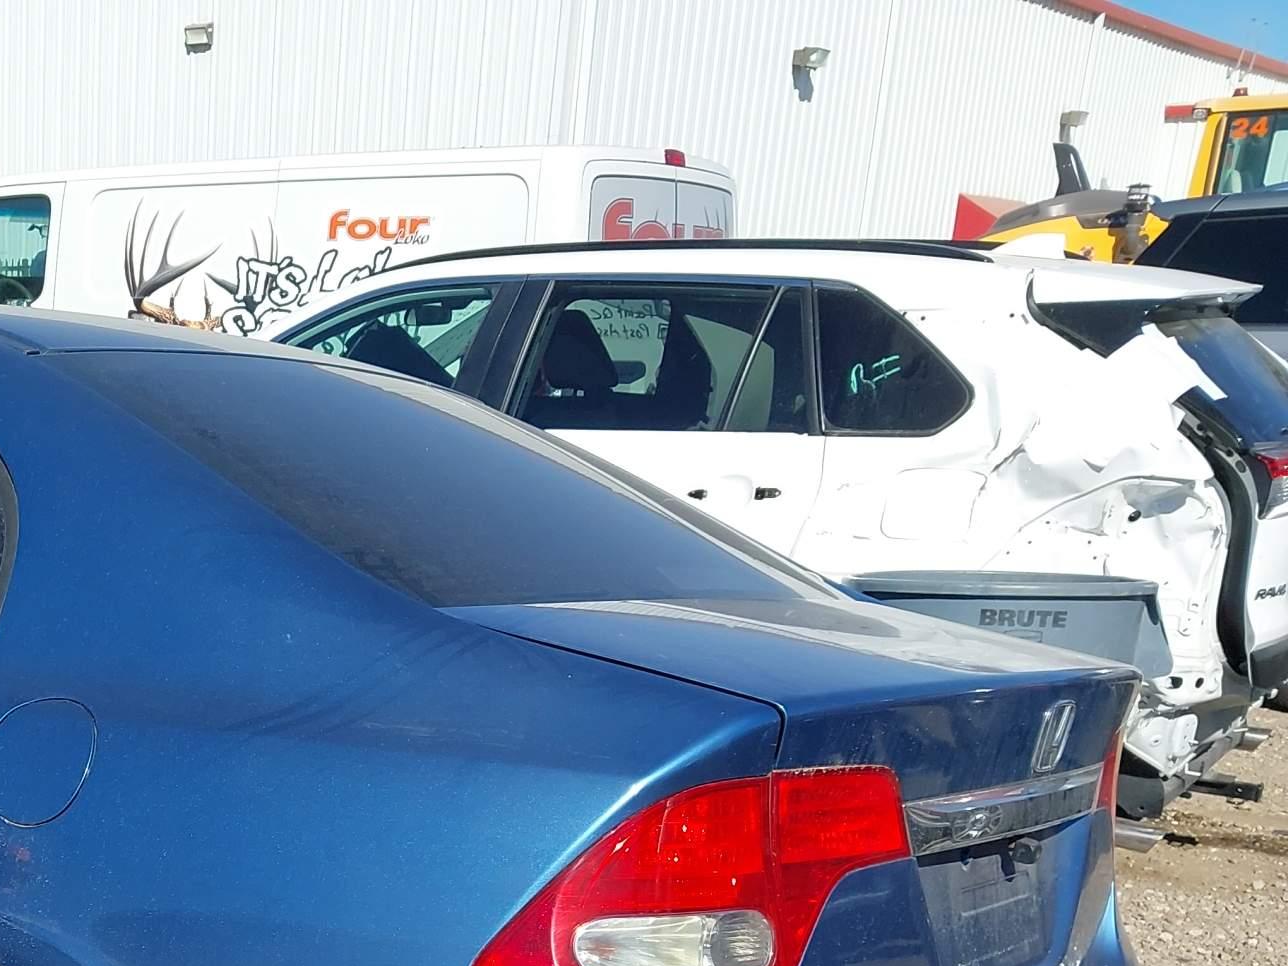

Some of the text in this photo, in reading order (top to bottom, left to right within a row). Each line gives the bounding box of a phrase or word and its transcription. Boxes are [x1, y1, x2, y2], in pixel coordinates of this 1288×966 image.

[1230, 116, 1268, 140] 24
[328, 209, 430, 241] four
[394, 228, 430, 246] Loko
[234, 256, 307, 307] IT'S
[979, 608, 1068, 628] BRUTE
